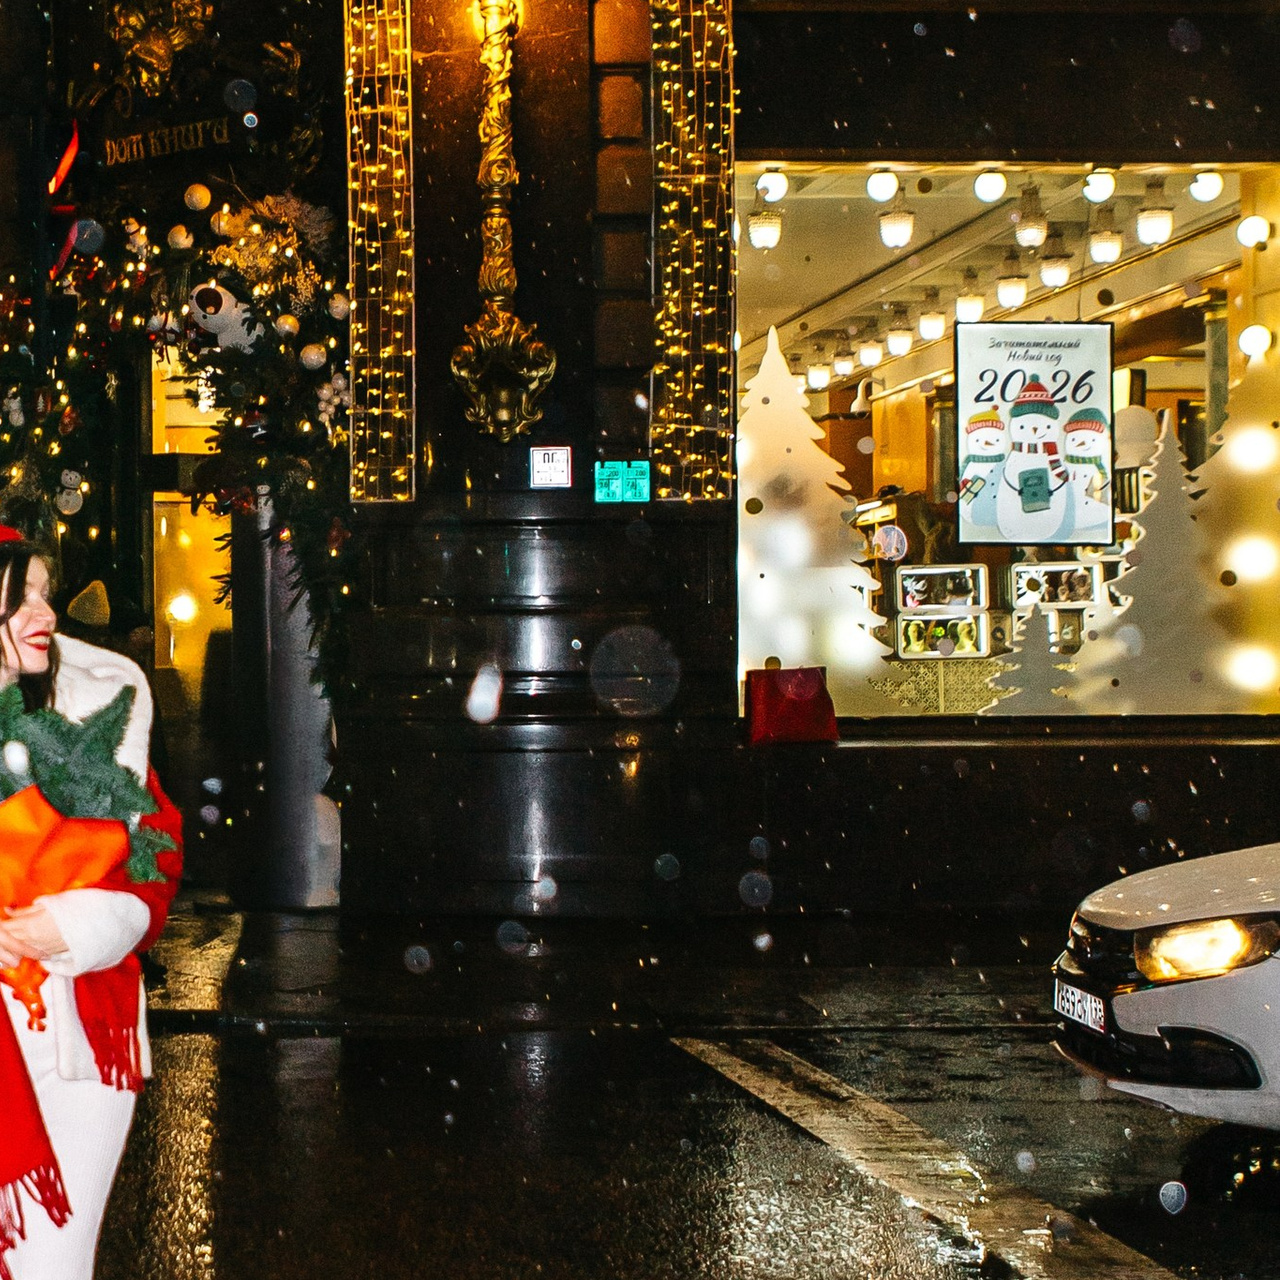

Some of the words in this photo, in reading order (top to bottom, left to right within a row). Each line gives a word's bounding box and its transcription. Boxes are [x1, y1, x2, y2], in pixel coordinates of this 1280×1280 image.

[1007, 349, 1042, 362] Новый
[1045, 353, 1063, 367] год
[974, 368, 1096, 404] 2026
